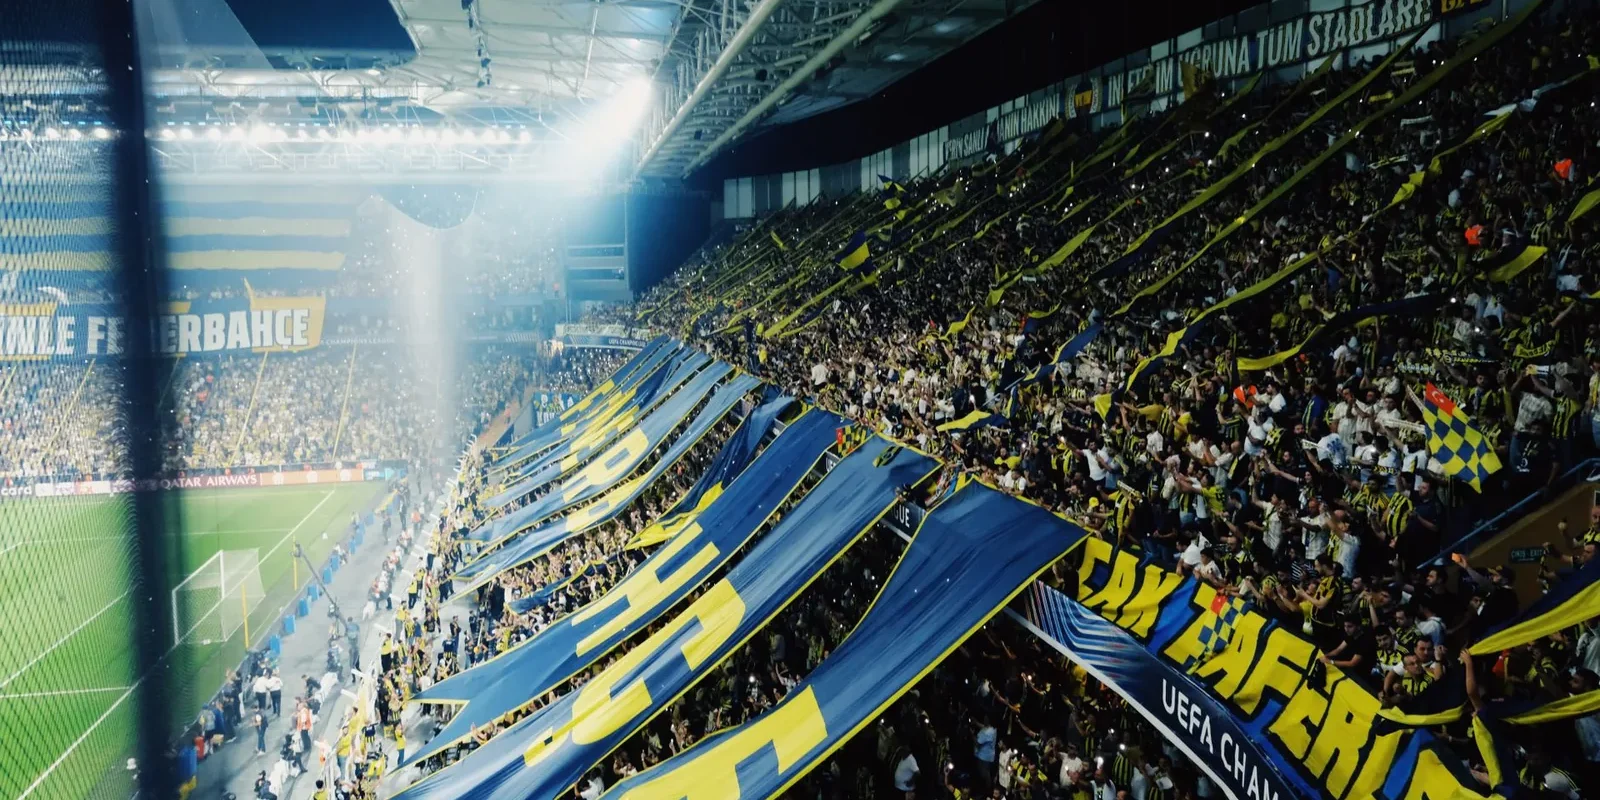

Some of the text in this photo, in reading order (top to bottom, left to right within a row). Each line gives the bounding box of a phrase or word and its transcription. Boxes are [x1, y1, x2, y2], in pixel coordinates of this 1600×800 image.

[1256, 17, 1304, 70] TÜM
[87, 308, 310, 355] FEERBAHÇE
[1, 485, 33, 496] card
[160, 473, 258, 490] QATAR AIRWAYS
[893, 502, 910, 528] GUE
[1162, 678, 1214, 755] UEFA
